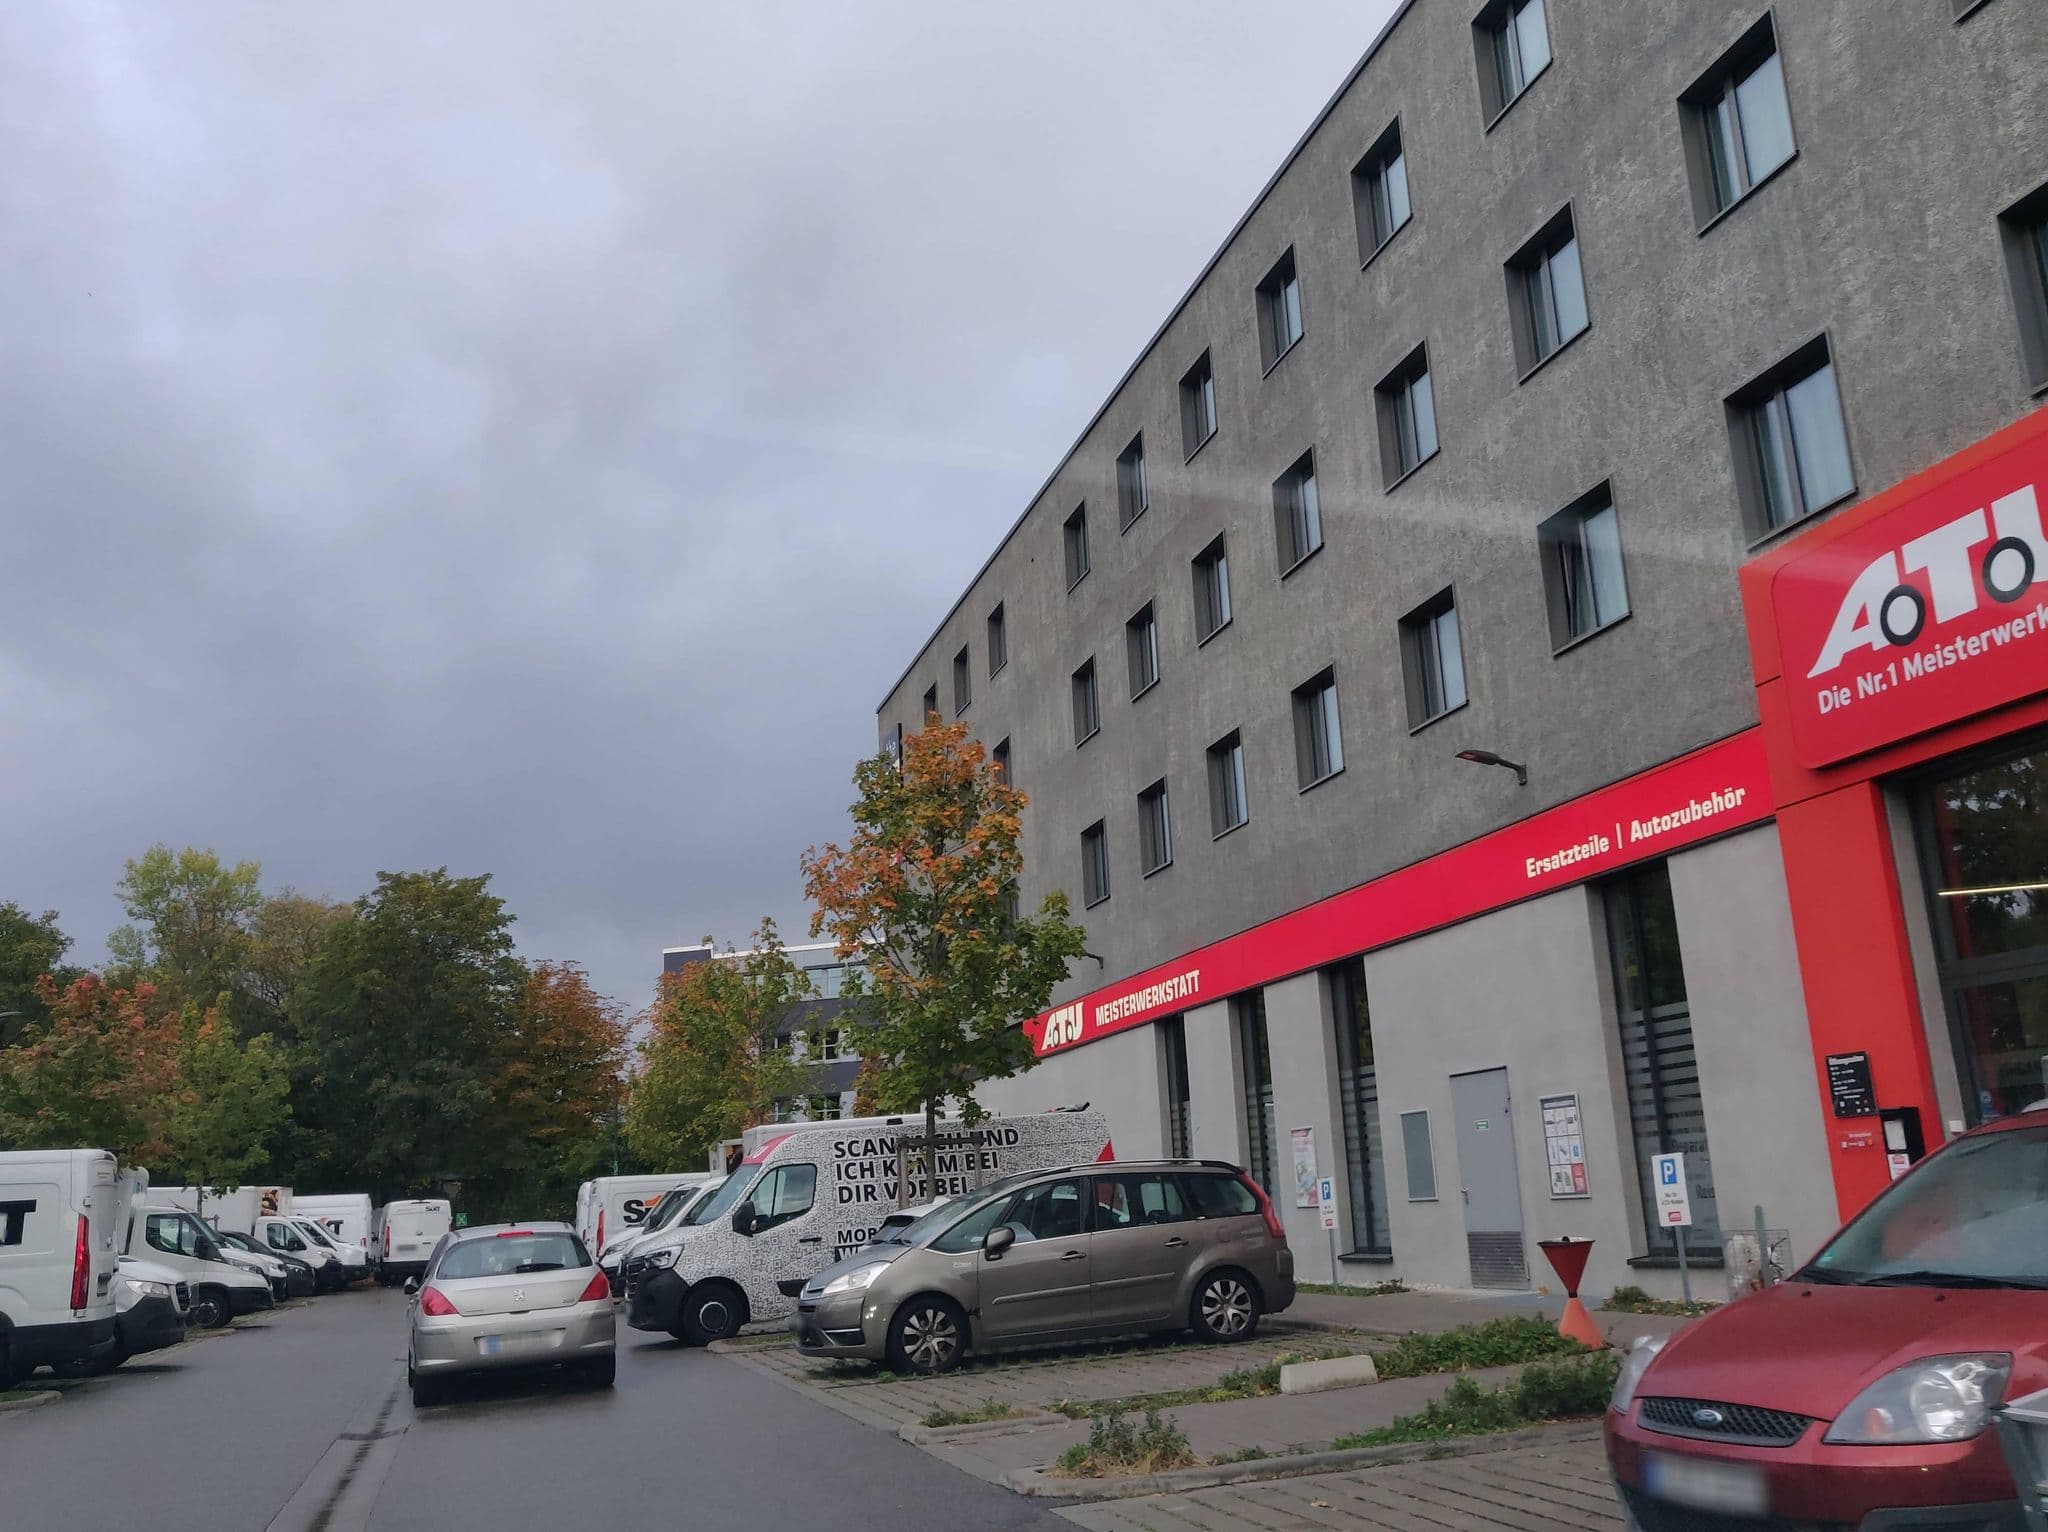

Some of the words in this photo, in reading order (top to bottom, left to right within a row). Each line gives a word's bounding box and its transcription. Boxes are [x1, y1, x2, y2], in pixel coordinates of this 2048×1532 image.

[1818, 686, 1851, 714] Die
[1525, 834, 1610, 878] Ersatzteile
[1630, 787, 1746, 842] Autozubehör
[1095, 969, 1200, 1027] MEISTERWERKSTATT
[834, 1137, 898, 1159] SCAN
[836, 1160, 875, 1181] ICH
[884, 1154, 959, 1178] KMM
[965, 1151, 998, 1170] BEI
[838, 1184, 878, 1204] DIR
